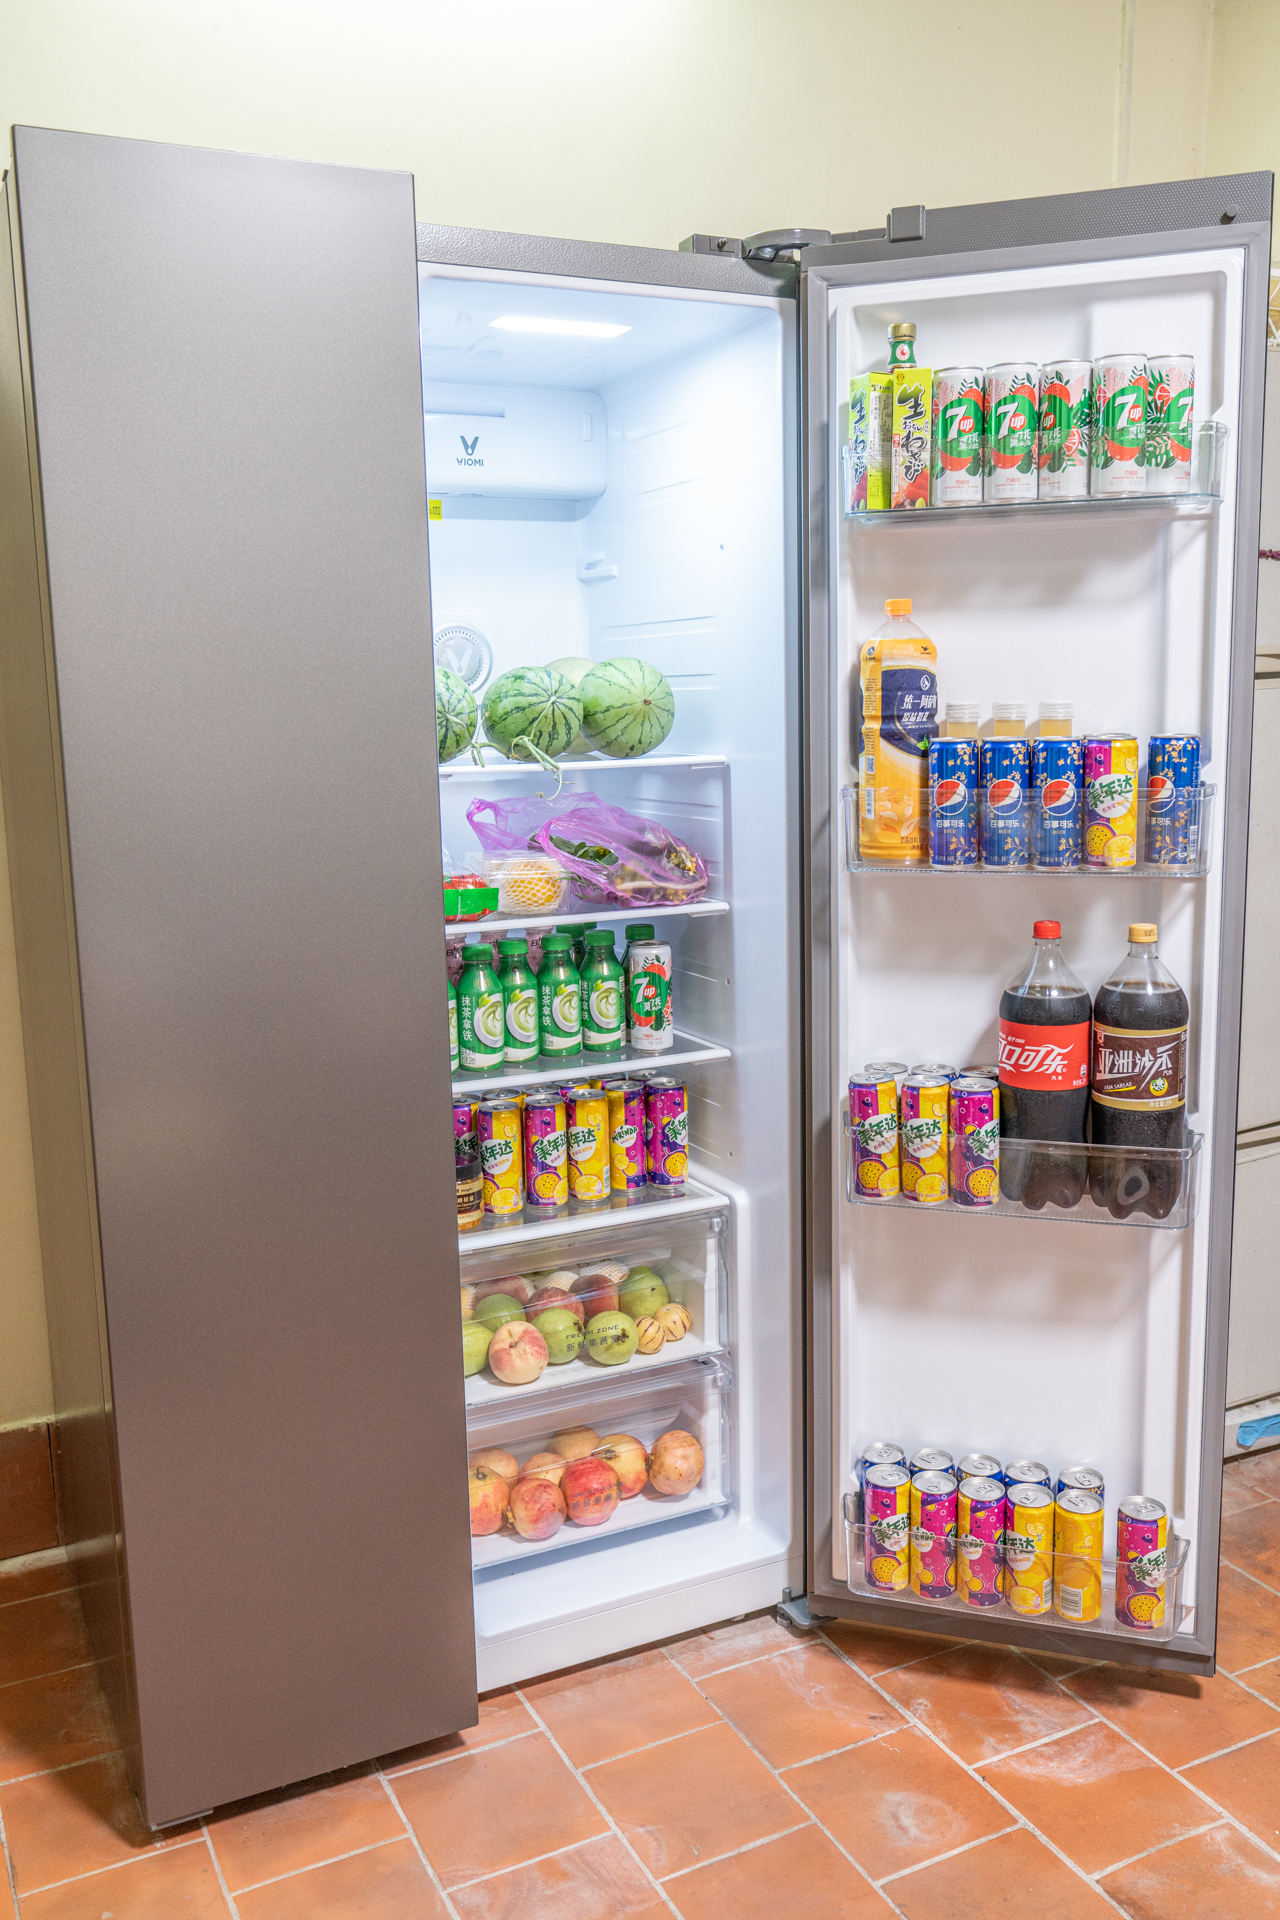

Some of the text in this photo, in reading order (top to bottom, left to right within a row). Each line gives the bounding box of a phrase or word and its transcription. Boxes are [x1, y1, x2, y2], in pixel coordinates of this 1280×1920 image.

[456, 458, 484, 467] VIOMI
[1087, 775, 1134, 809] 美年达
[936, 820, 965, 828] 百事可乐
[990, 820, 1020, 828] 百事可乐
[1043, 821, 1074, 829] 百事可乐
[541, 985, 552, 1026] 抹茶拿铁
[461, 995, 473, 1042] 抹茶拿铁
[1096, 1040, 1180, 1091] 亚洲沙示
[611, 1126, 638, 1143] MIRINDA
[566, 1325, 619, 1340] FRESH ZONE
[572, 1481, 623, 1498] FRESH ZONE
